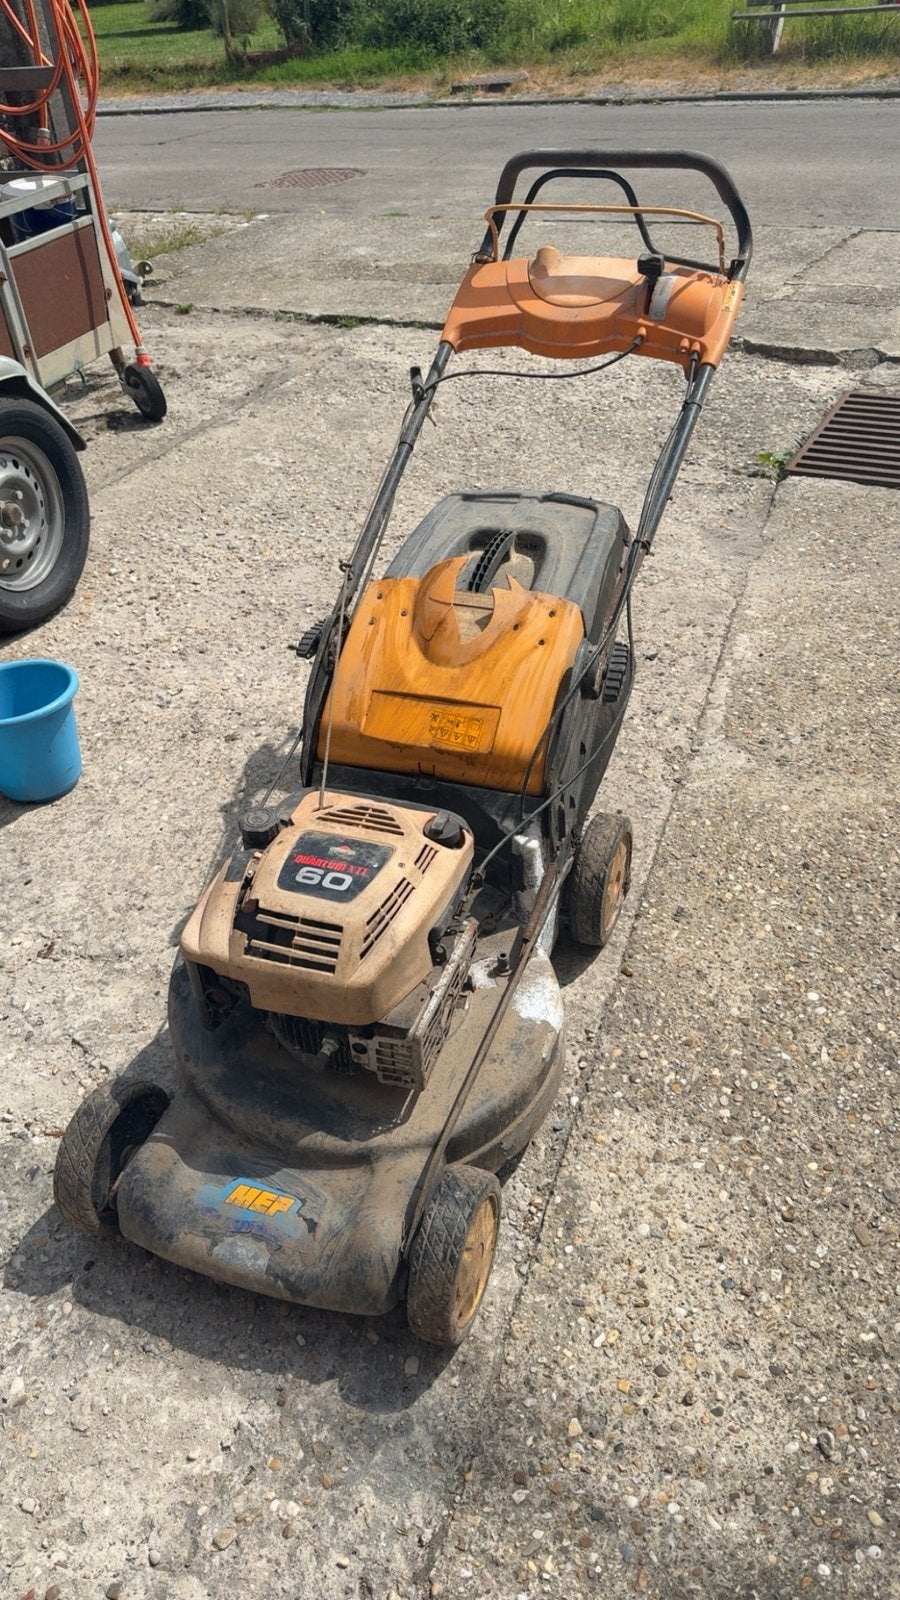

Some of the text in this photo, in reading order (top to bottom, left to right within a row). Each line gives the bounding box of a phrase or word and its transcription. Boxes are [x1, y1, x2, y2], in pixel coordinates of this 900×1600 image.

[294, 854, 346, 872] QUANTUM
[295, 866, 353, 891] 60
[224, 1184, 297, 1217] MEP
